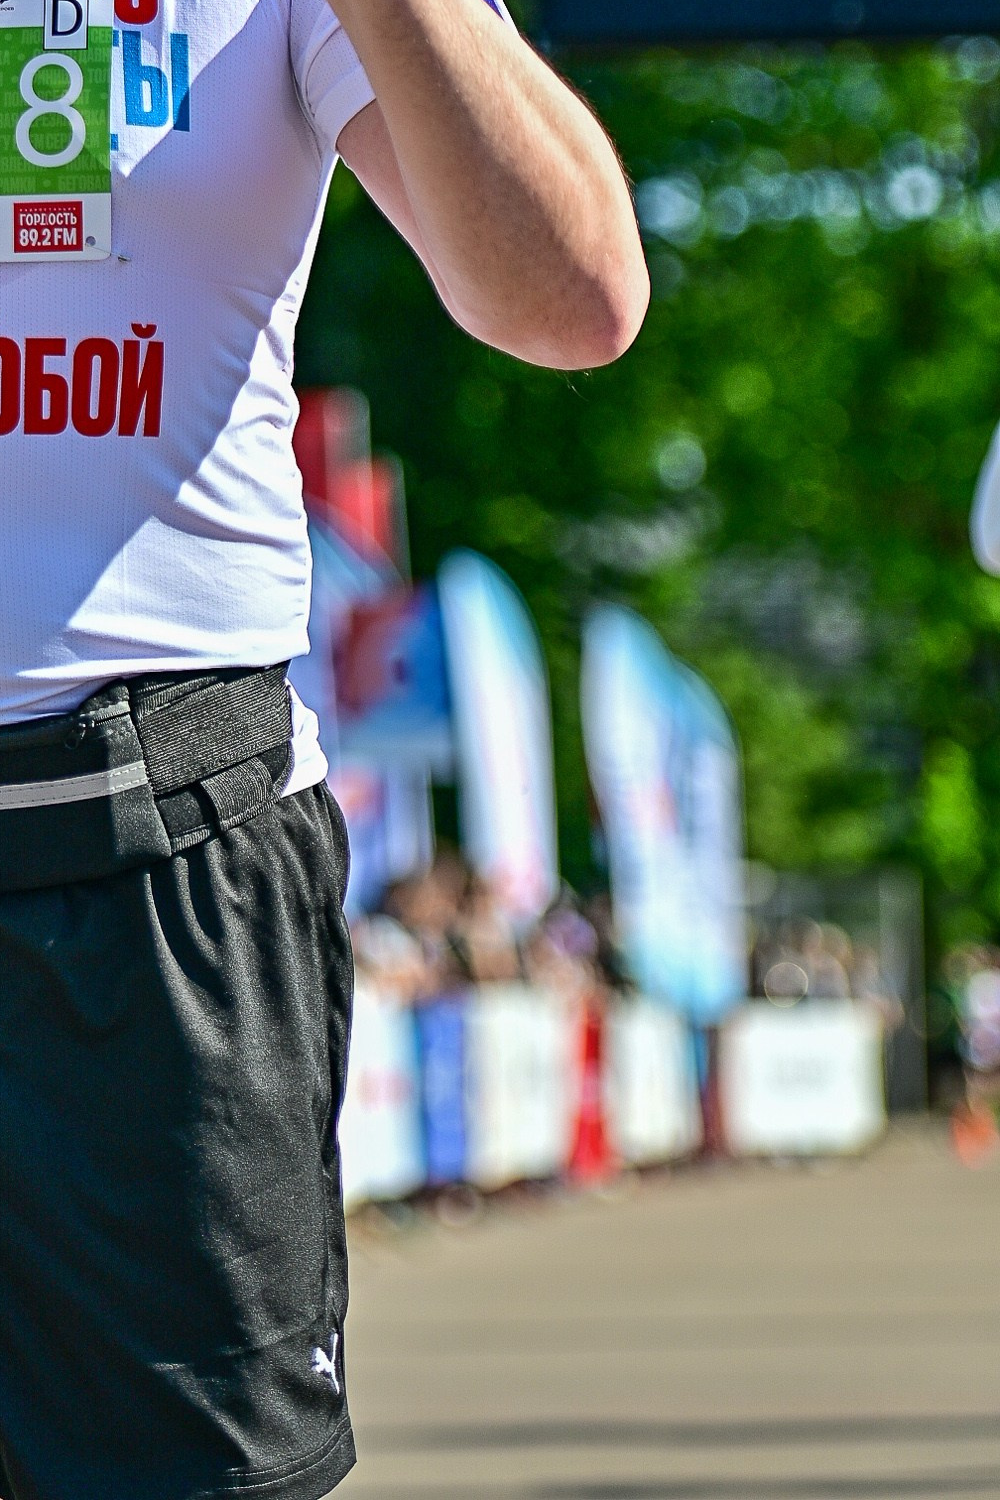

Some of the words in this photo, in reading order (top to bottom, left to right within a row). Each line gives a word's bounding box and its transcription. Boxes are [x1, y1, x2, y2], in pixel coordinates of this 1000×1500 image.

[19, 212, 78, 227] ГОРДОСТЬ
[19, 228, 52, 248] 89.2
[53, 227, 77, 246] FM
